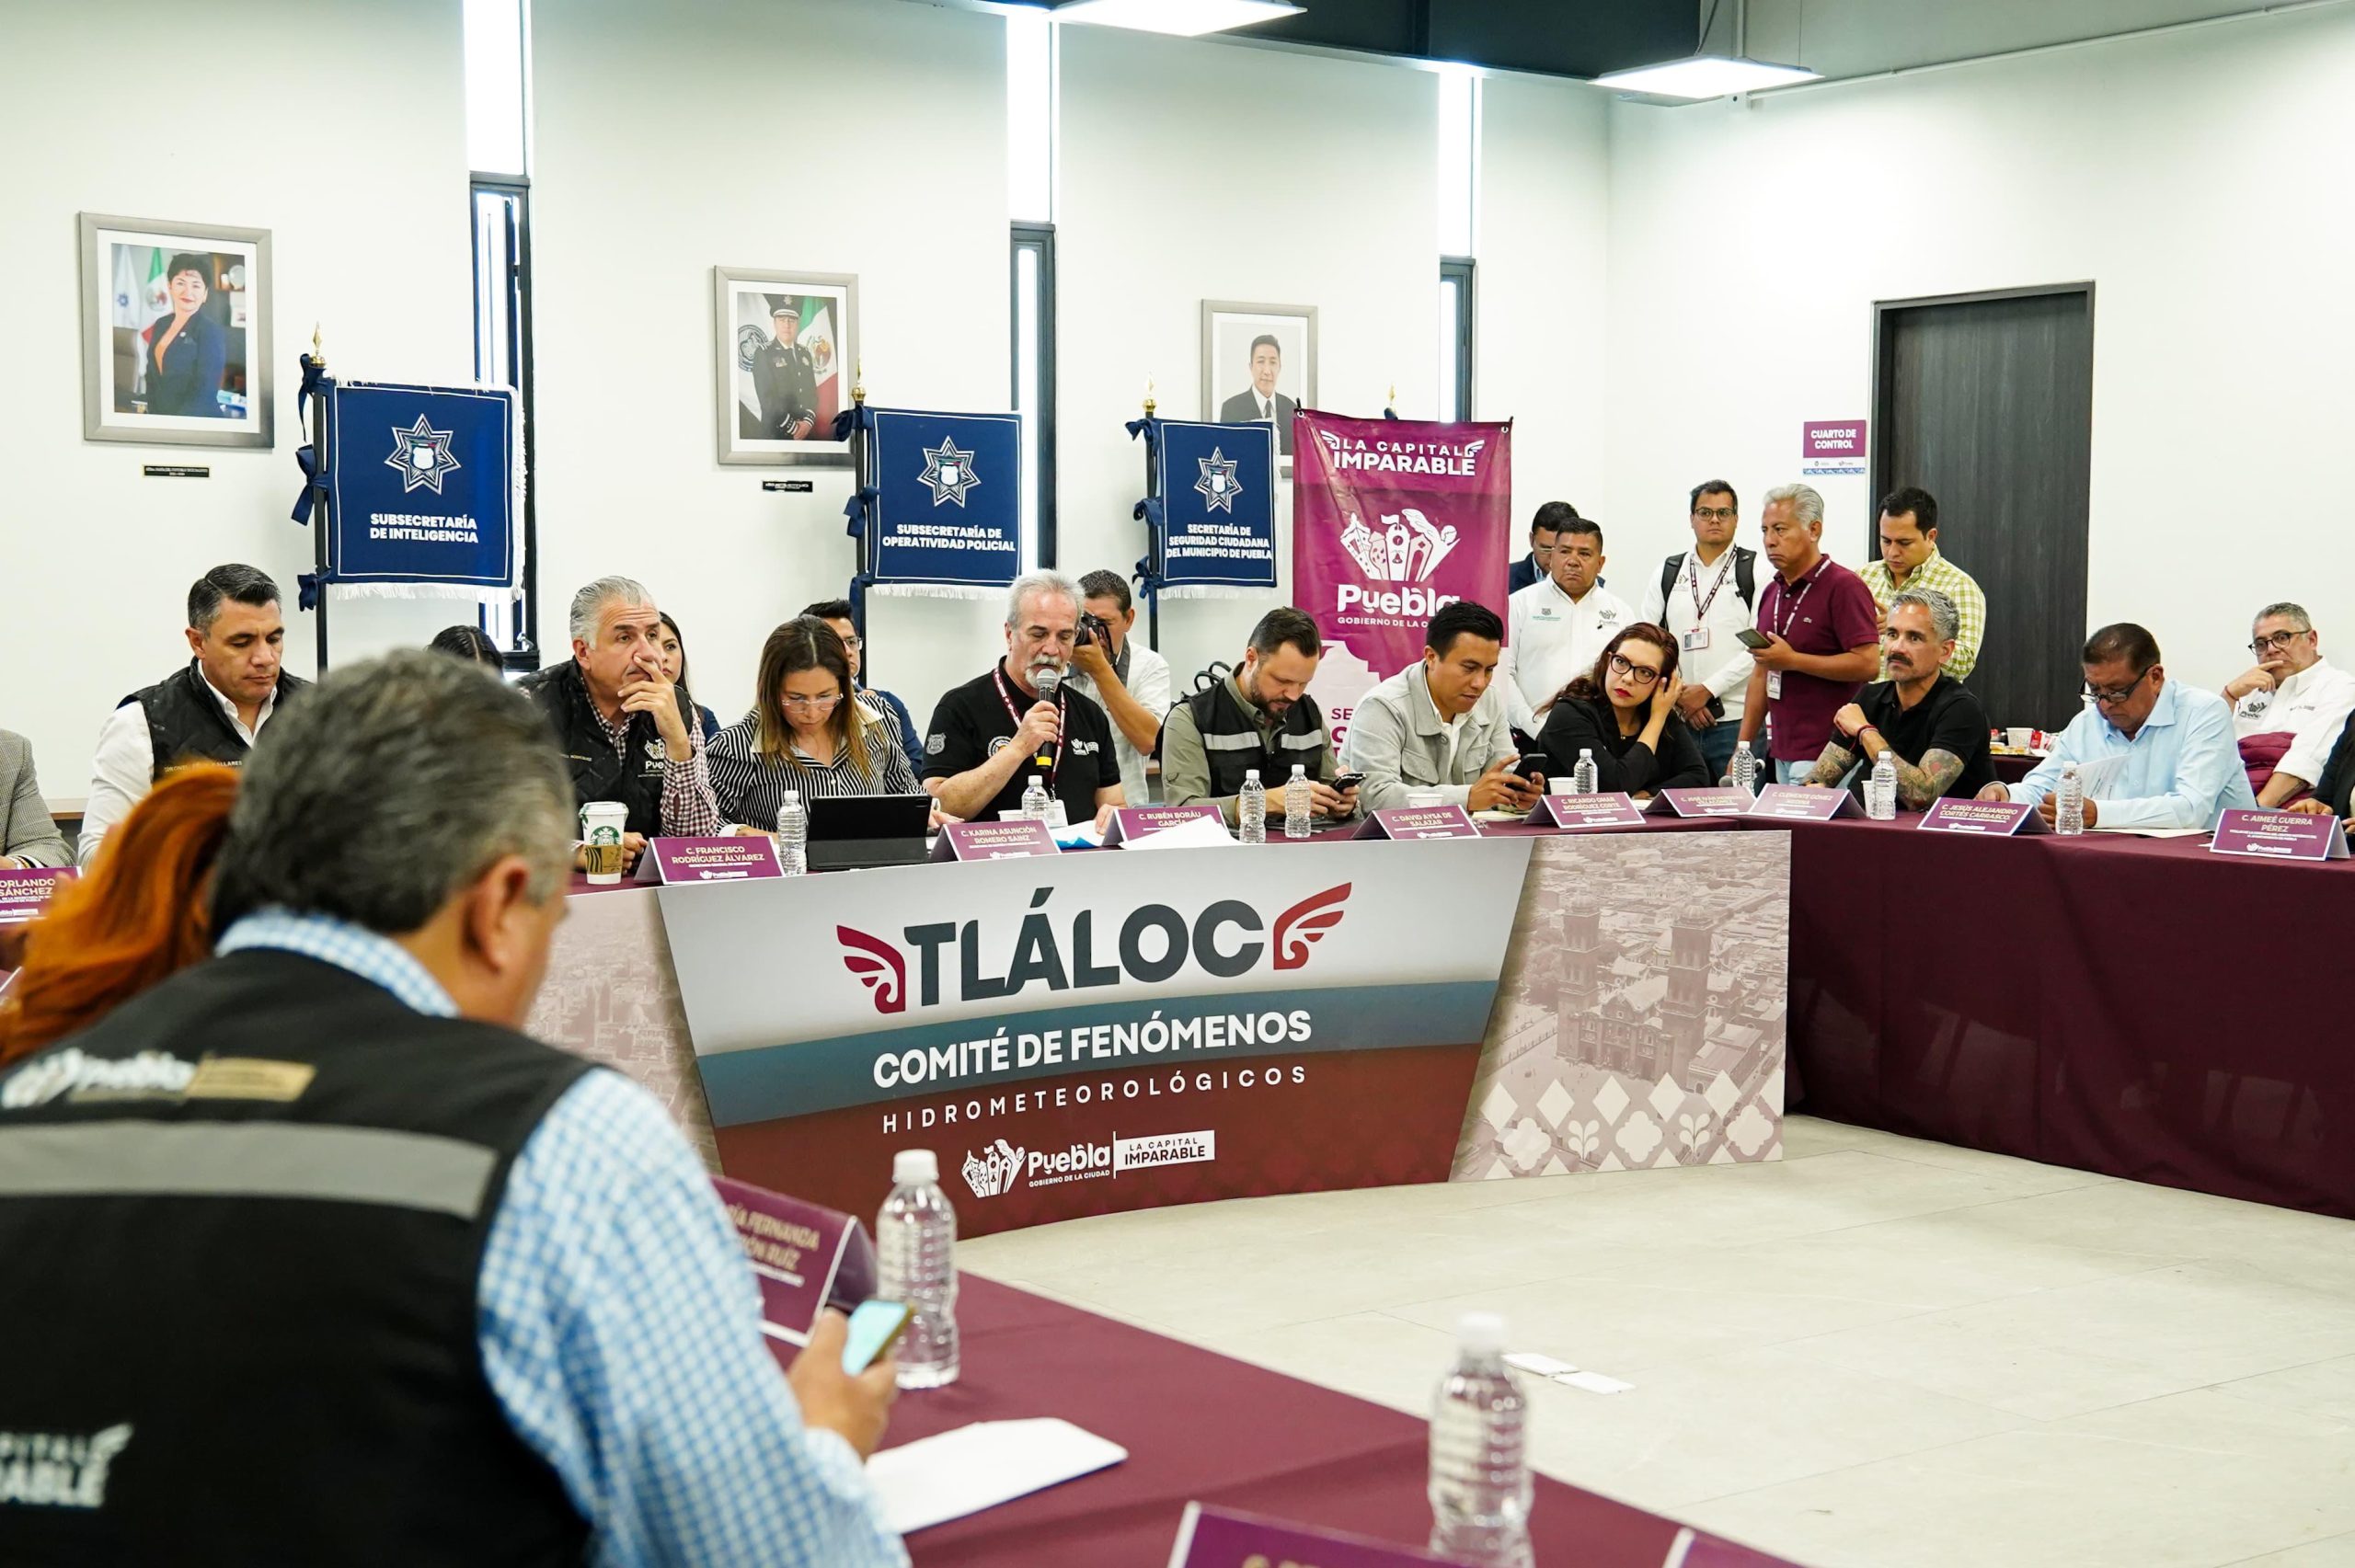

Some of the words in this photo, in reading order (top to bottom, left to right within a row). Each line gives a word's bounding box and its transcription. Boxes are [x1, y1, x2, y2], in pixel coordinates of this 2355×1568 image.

[1810, 429, 1844, 439] CUARTO
[1845, 429, 1857, 438] DE
[1343, 438, 1367, 450] LA
[1376, 441, 1463, 457] CAPITAL
[1814, 440, 1854, 450] CONTROL
[1334, 451, 1476, 475] IMPARABLE
[370, 513, 477, 530] SUBSECRETARÍA
[897, 524, 986, 538] SUBSECRETARÍA
[987, 528, 1003, 539] DE
[1187, 523, 1239, 535] SECRETARÍA
[1240, 526, 1251, 536] DE
[370, 528, 387, 539] DE
[389, 528, 478, 544] INTELIGENCIA
[1168, 536, 1217, 546] SEGURIDAD
[1218, 537, 1270, 548] CIUDADANA
[882, 536, 966, 549] OPERATIVIDAD
[967, 539, 1016, 551] POLICIAL
[1166, 548, 1182, 558] DEL
[1182, 548, 1229, 557] MUNICIPIO
[1229, 550, 1241, 558] DE
[1241, 550, 1273, 559] PUEBLA
[1337, 616, 1390, 626] GOBIERNO
[1392, 619, 1405, 627] DE
[1407, 620, 1419, 628] LA
[1147, 810, 1174, 820] RUBÉN
[1174, 809, 1201, 818] BORÁU
[1939, 809, 1969, 818] CORTÉS
[1949, 804, 1972, 812] JESÚS
[1972, 806, 2018, 815] ALEJANDRO
[2260, 823, 2290, 832] PÉREZ
[2278, 817, 2313, 826] GUERRA
[969, 828, 998, 837] KARINA
[998, 825, 1037, 836] ASUNCIÓN
[974, 835, 1007, 844] ROMERO
[695, 845, 745, 854] FRANCISCO
[672, 854, 724, 864] RODRÍGUEZ
[725, 852, 764, 863] ÁLVAREZ
[0, 878, 55, 888] ORLANDO
[904, 887, 1265, 1007] TLÁLOC
[873, 1027, 1009, 1089] COMITÉ
[1017, 1030, 1063, 1068] DE
[1070, 1010, 1312, 1061] FENÓMENOS
[882, 1066, 1305, 1134] HIDROMETEOROLÓGICOS
[1148, 1137, 1198, 1150] CAPITAL
[1028, 1143, 1110, 1178] Puebla
[1125, 1145, 1206, 1166] IMPARABLE
[1028, 1176, 1063, 1188] GOBIERNO
[1064, 1174, 1074, 1183] DE
[1074, 1173, 1083, 1181] LA
[1084, 1169, 1110, 1180] CIUDAD
